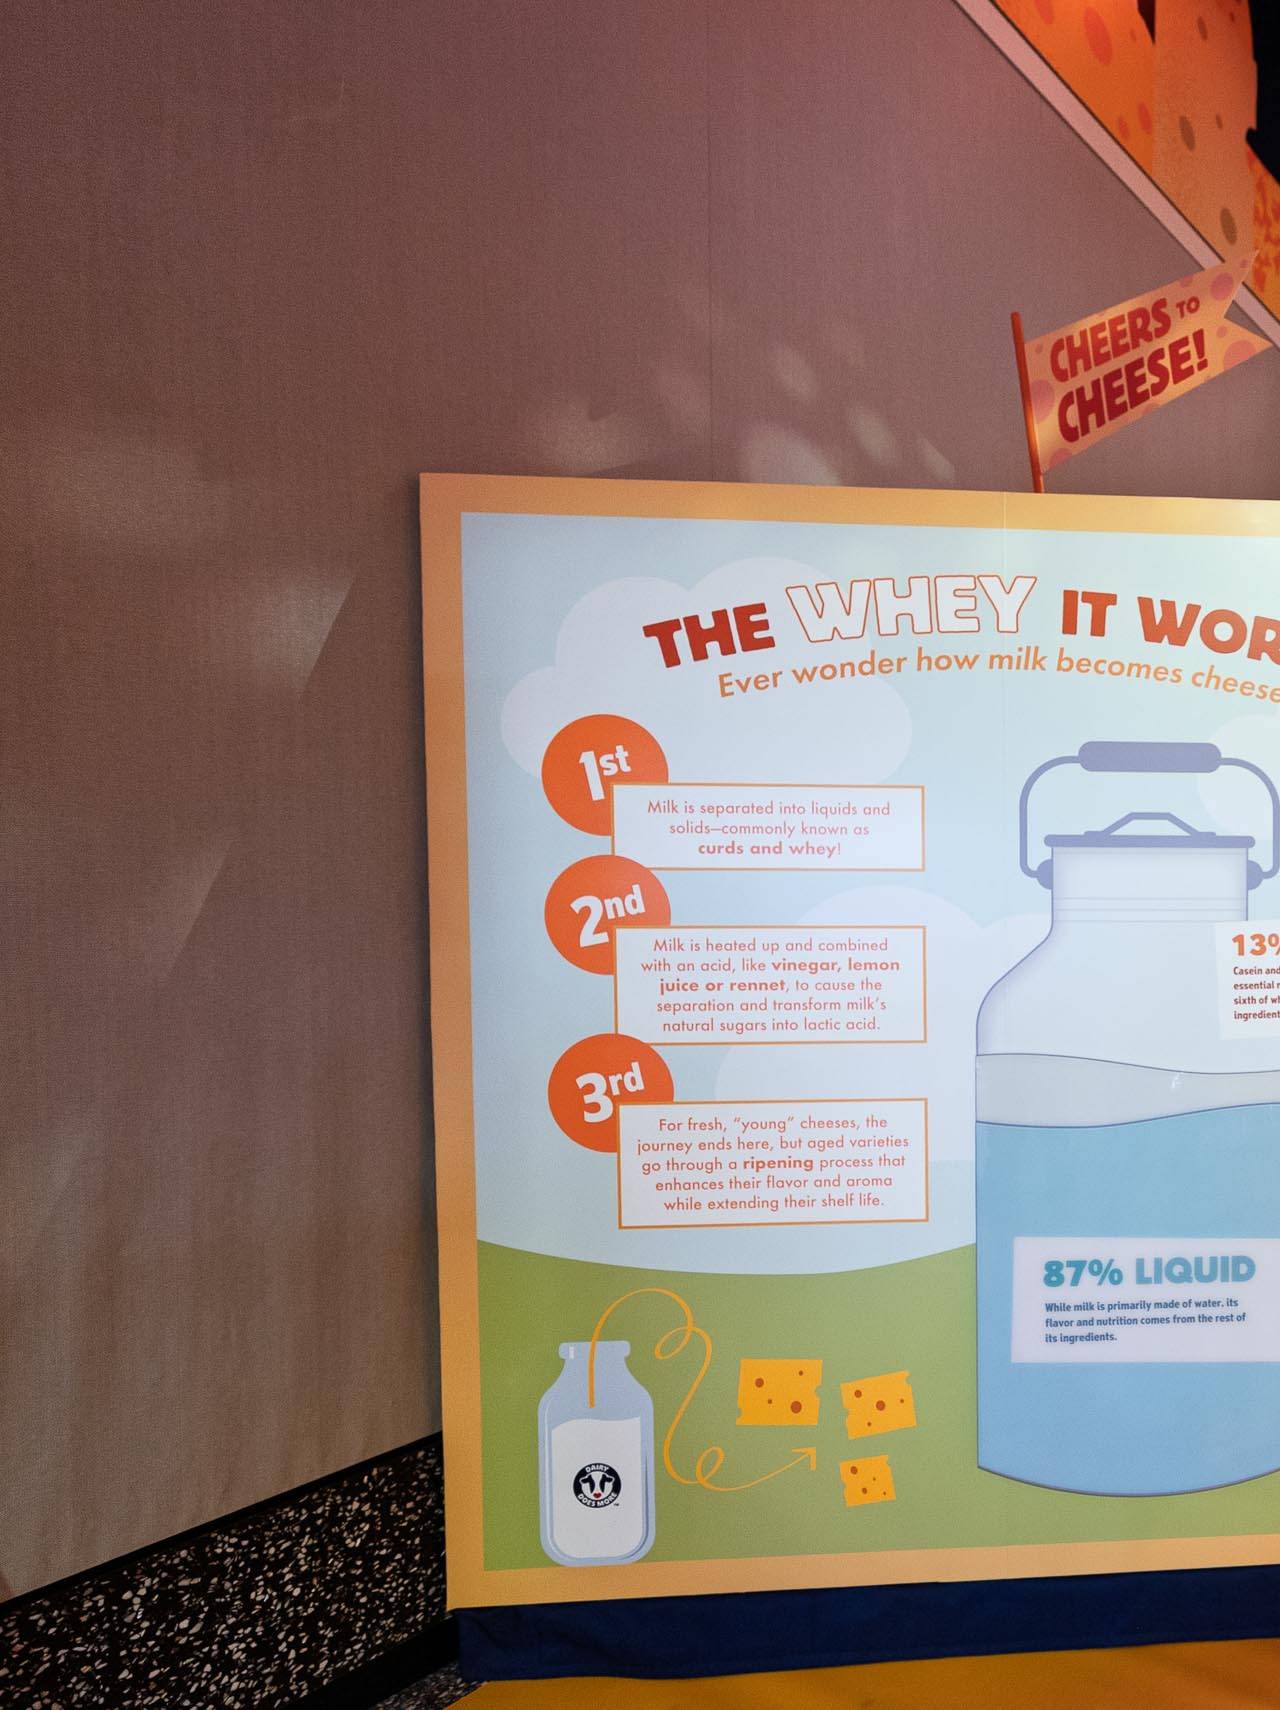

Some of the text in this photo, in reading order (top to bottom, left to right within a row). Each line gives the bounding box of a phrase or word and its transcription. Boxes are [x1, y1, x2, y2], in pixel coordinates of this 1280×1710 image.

[1050, 296, 1200, 382] CHEERS TO
[1058, 329, 1208, 442] CHEESE!
[642, 602, 776, 669] THE
[786, 574, 1038, 643] WHEY
[1062, 589, 1118, 637] IT
[718, 668, 784, 699] Ever
[791, 646, 905, 684] wonder
[916, 647, 976, 672] how
[990, 646, 1046, 672] milk
[1056, 648, 1182, 683] becomes
[579, 745, 631, 801] 1st
[647, 799, 891, 820] Milk is separated into liquids and
[669, 819, 870, 839] solids—commonly known as
[698, 839, 841, 859] curds and whey!
[570, 884, 646, 948] 2nd
[653, 936, 888, 956] Milk is heated up and combined
[640, 956, 900, 975] with an acid, like vinegar, lemon
[1232, 965, 1263, 976] Casein
[660, 976, 883, 996] juice or rennet, to cause the
[1233, 980, 1275, 991] essential
[656, 998, 735, 1017] separation
[739, 997, 768, 1012] and
[772, 996, 841, 1011] transform
[1233, 995, 1257, 1006] sixth
[1258, 994, 1269, 1005] of
[662, 1015, 881, 1035] natural sugars into lactic acid.
[576, 1061, 644, 1123] 3rd
[659, 1114, 888, 1135] For fresh, "young" cheeses, the
[637, 1134, 909, 1156] journey ends here, but aged varieties
[641, 1152, 906, 1176] go through a ripening process that
[655, 1173, 893, 1192] enhances their flavor and aroma
[663, 1191, 884, 1213] while extending their shelf life.
[1043, 1255, 1256, 1287] 87% LIQUID
[1044, 1302, 1072, 1313] While
[1073, 1301, 1095, 1312] milk
[1096, 1301, 1106, 1311] is
[1107, 1299, 1152, 1313] primarily
[1153, 1299, 1181, 1310] made
[1181, 1298, 1193, 1309] of
[1226, 1297, 1239, 1308] its
[1045, 1311, 1247, 1328] flavor and nutrition comes from the rest of
[1044, 1331, 1118, 1345] its ingredients.
[578, 1492, 617, 1507] DOES MORE
